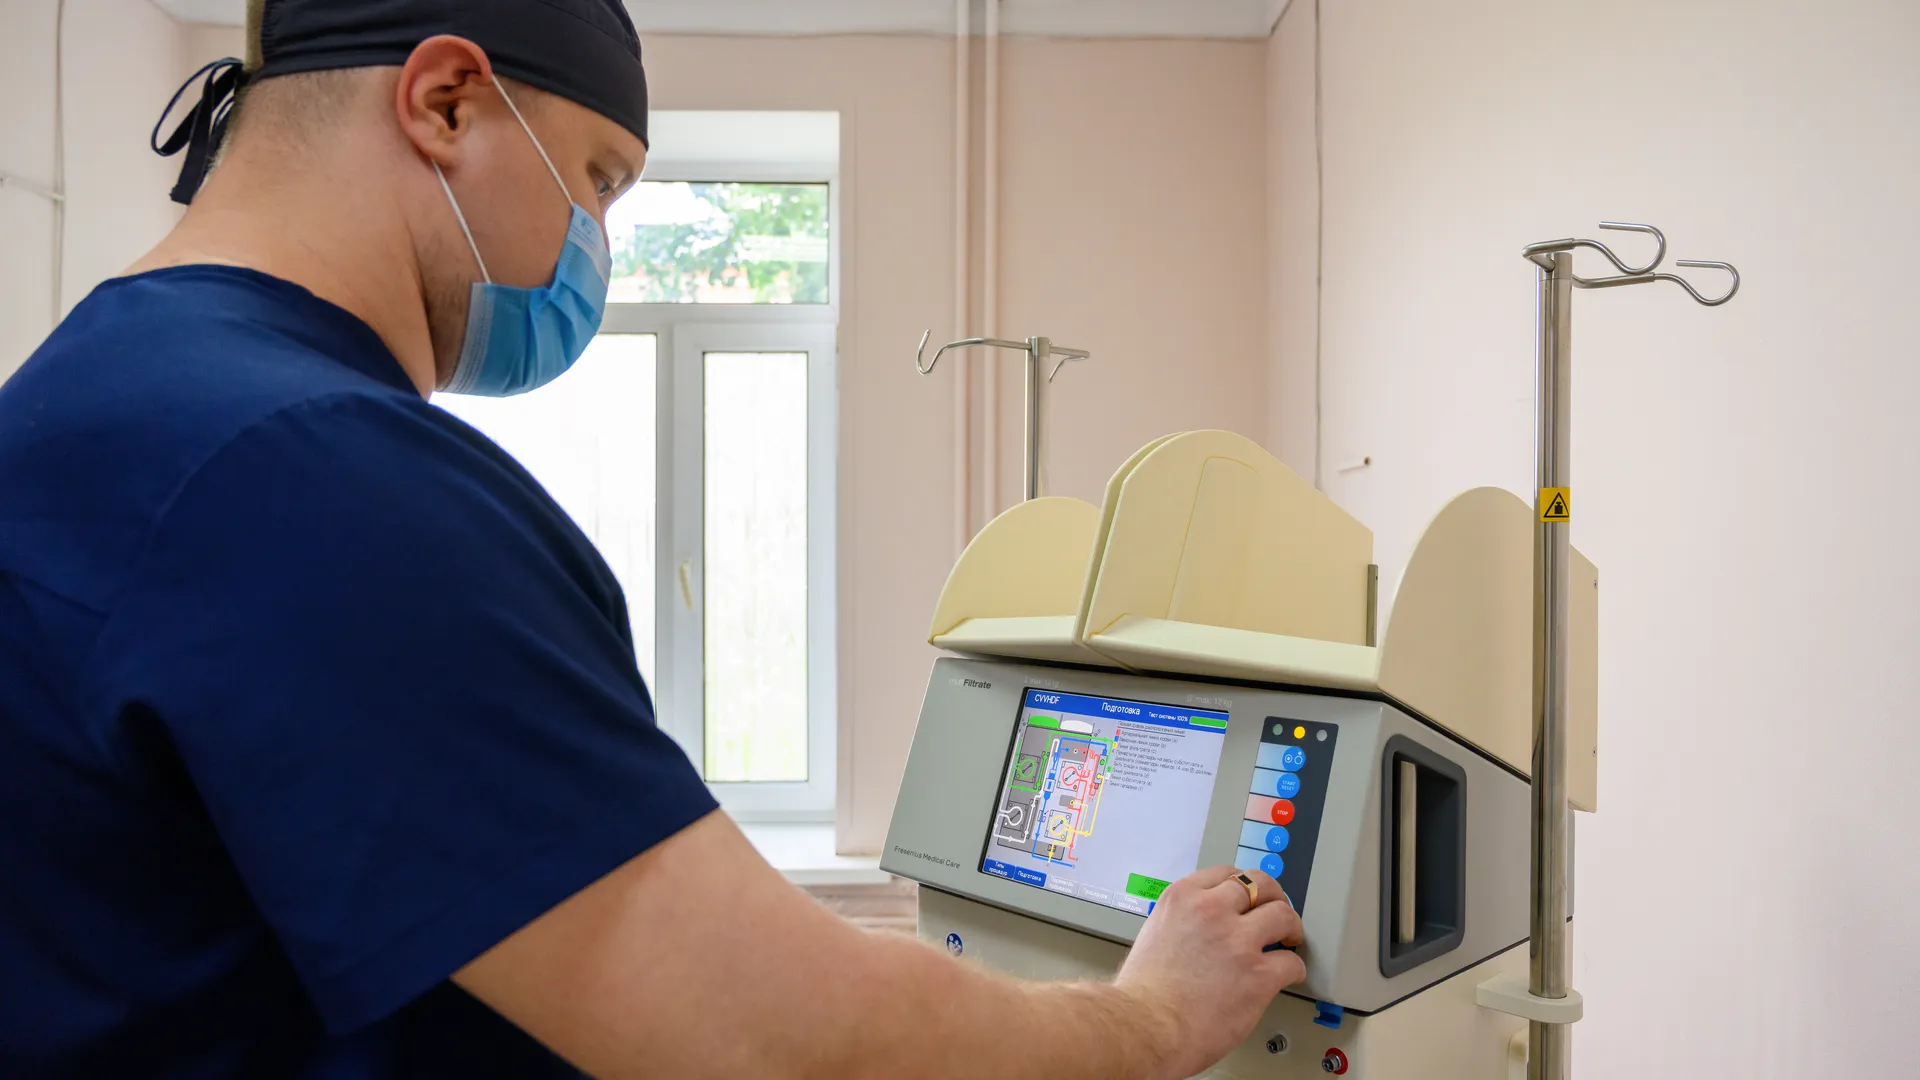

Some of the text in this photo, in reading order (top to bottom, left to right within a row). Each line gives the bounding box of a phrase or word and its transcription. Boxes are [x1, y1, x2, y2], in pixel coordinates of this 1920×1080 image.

[1034, 693, 1060, 705] CVVHDF
[1101, 702, 1141, 716] Подготовка
[1148, 711, 1158, 719] Тест
[894, 845, 961, 869] Fresenius Medical Care
[1018, 870, 1042, 882] Подготовка
